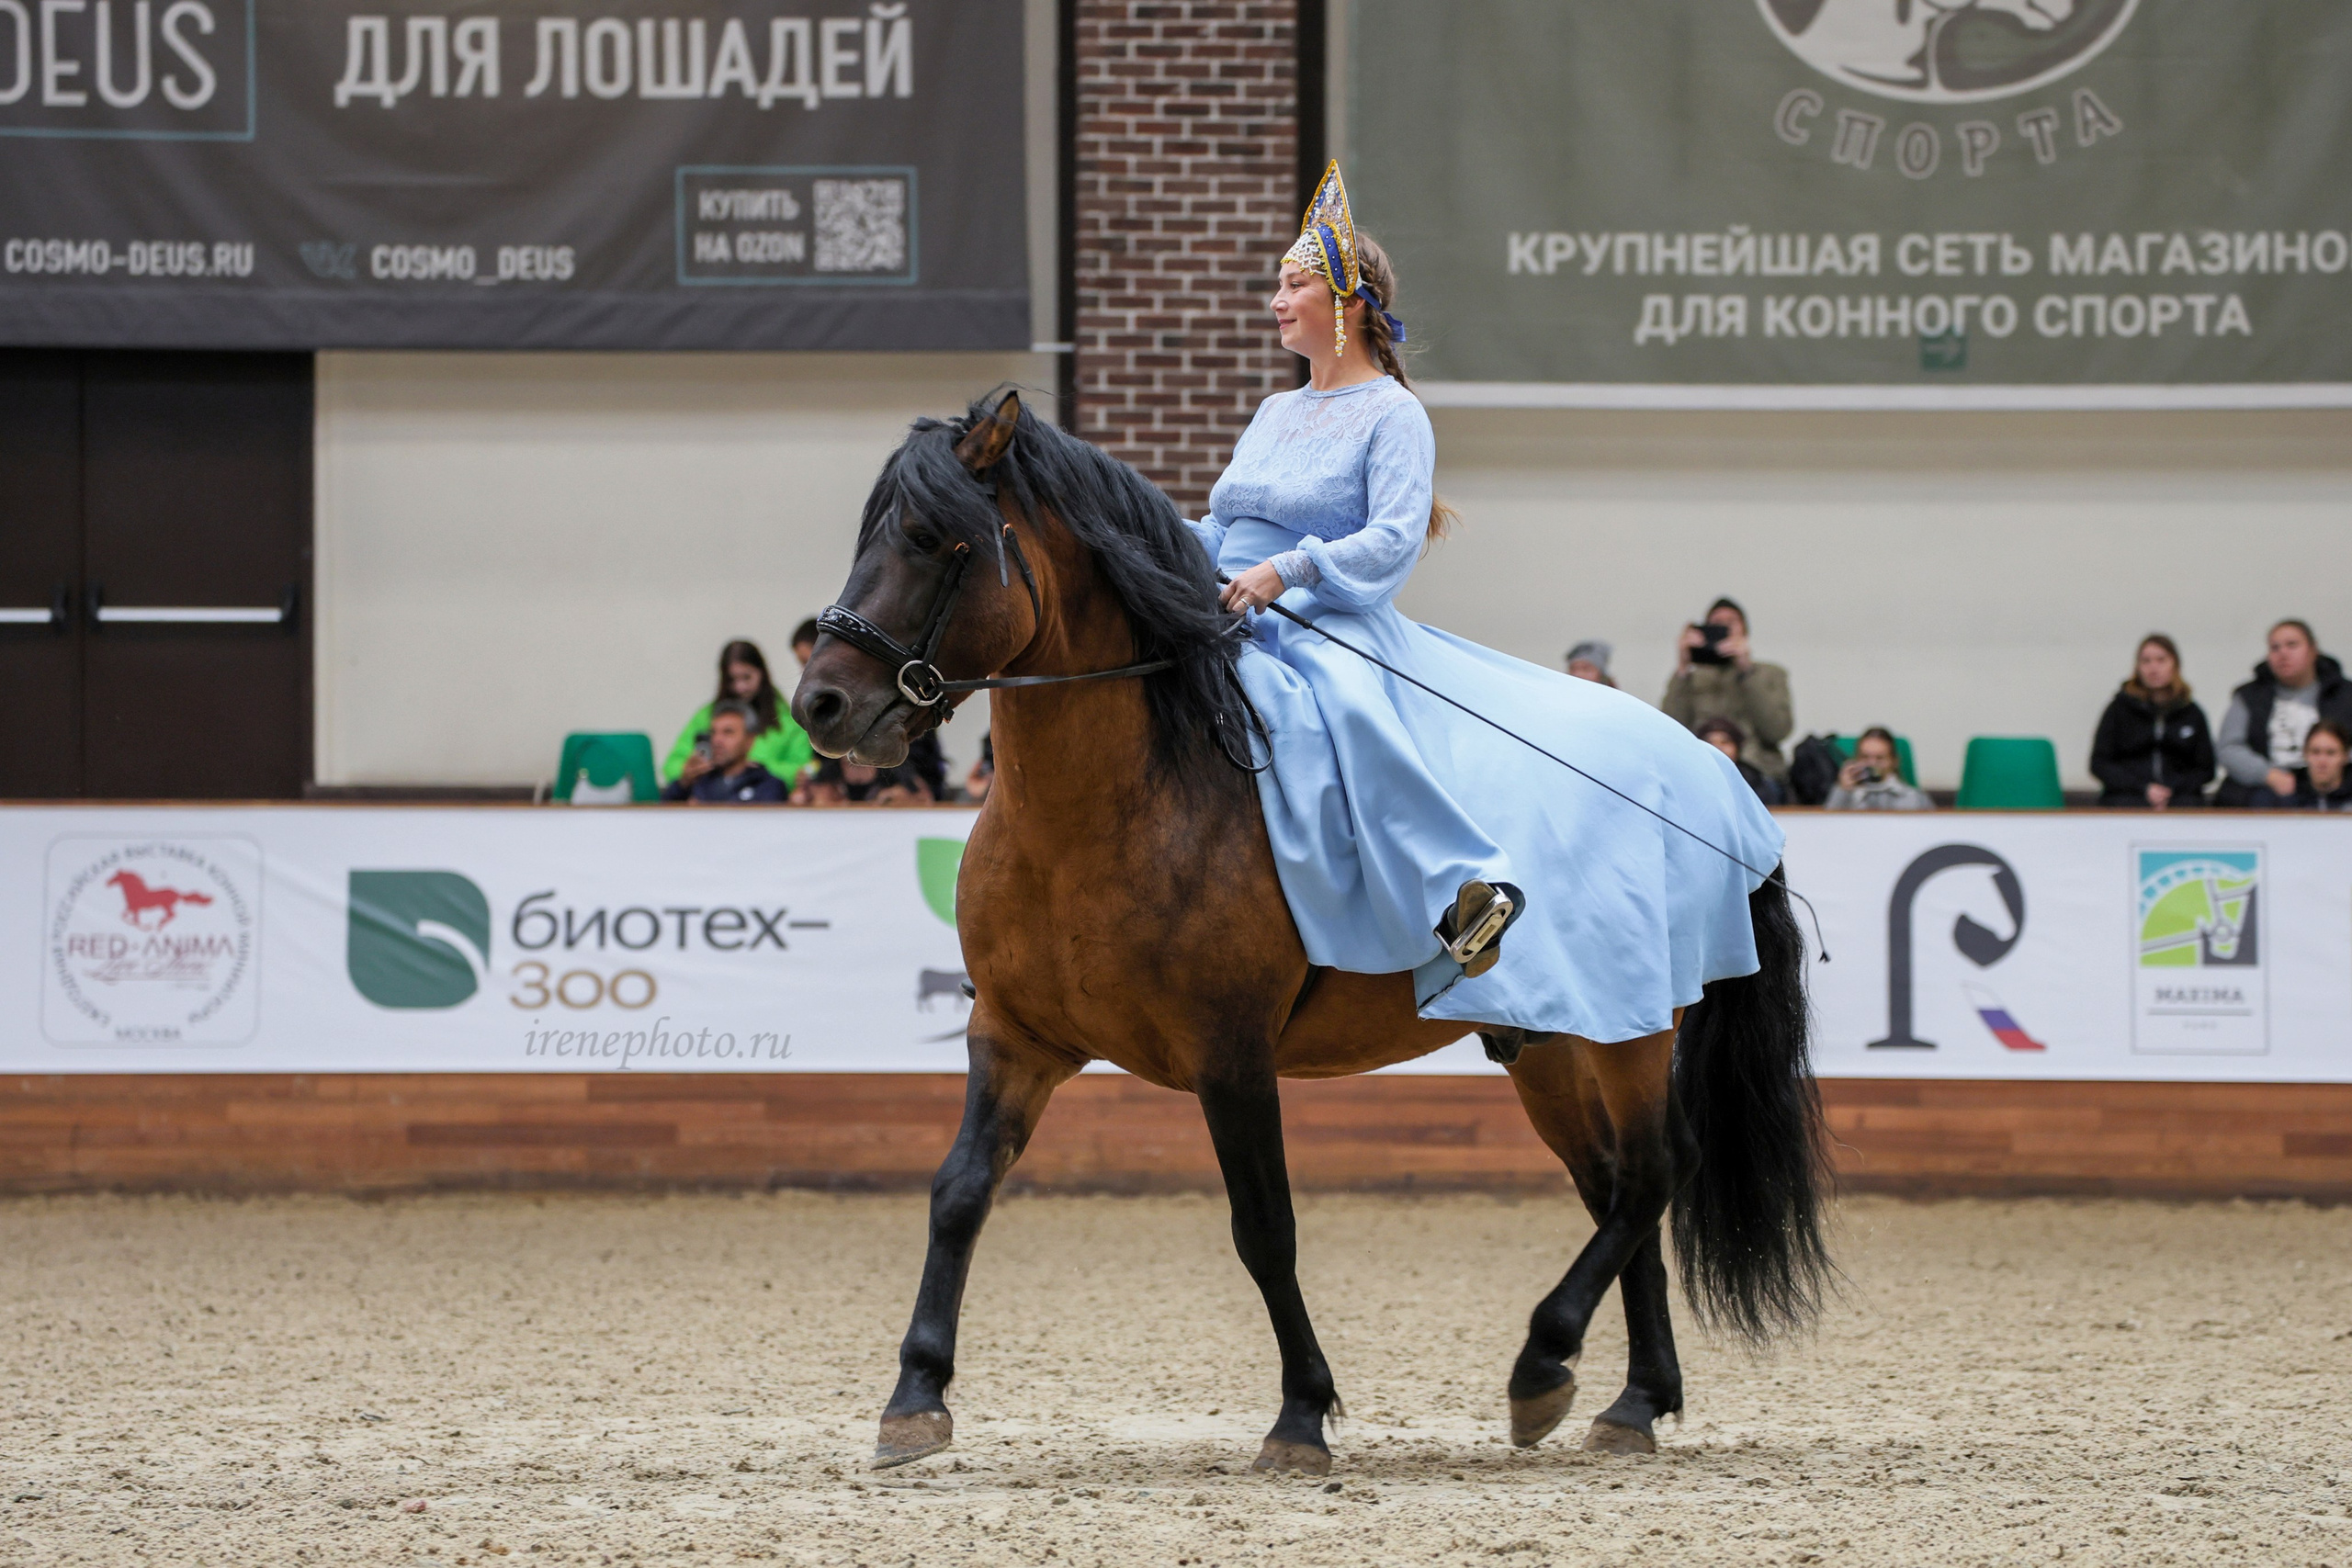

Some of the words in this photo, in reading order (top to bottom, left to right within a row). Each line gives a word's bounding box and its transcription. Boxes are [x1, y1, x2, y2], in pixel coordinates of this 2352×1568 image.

[334, 16, 501, 108] ДЛЯ
[525, 2, 912, 110] ЛОШАДЕЙ
[1772, 87, 2123, 180] СПОРТА
[698, 189, 800, 220] КУПИТЬ
[5, 239, 254, 276] COSMO-DEUS.RU
[370, 244, 575, 286] COSMO_DEUS
[695, 232, 732, 263] НА
[736, 231, 805, 263] OZON
[1508, 225, 1881, 276] КРУПНЕЙШАЯ
[1895, 232, 2033, 276] СЕТЬ
[2049, 231, 2352, 276] МАГАЗИНО
[1634, 294, 1748, 345] ДЛЯ
[1762, 295, 2018, 338] КОННОГО
[2033, 294, 2252, 338] СПОРТА
